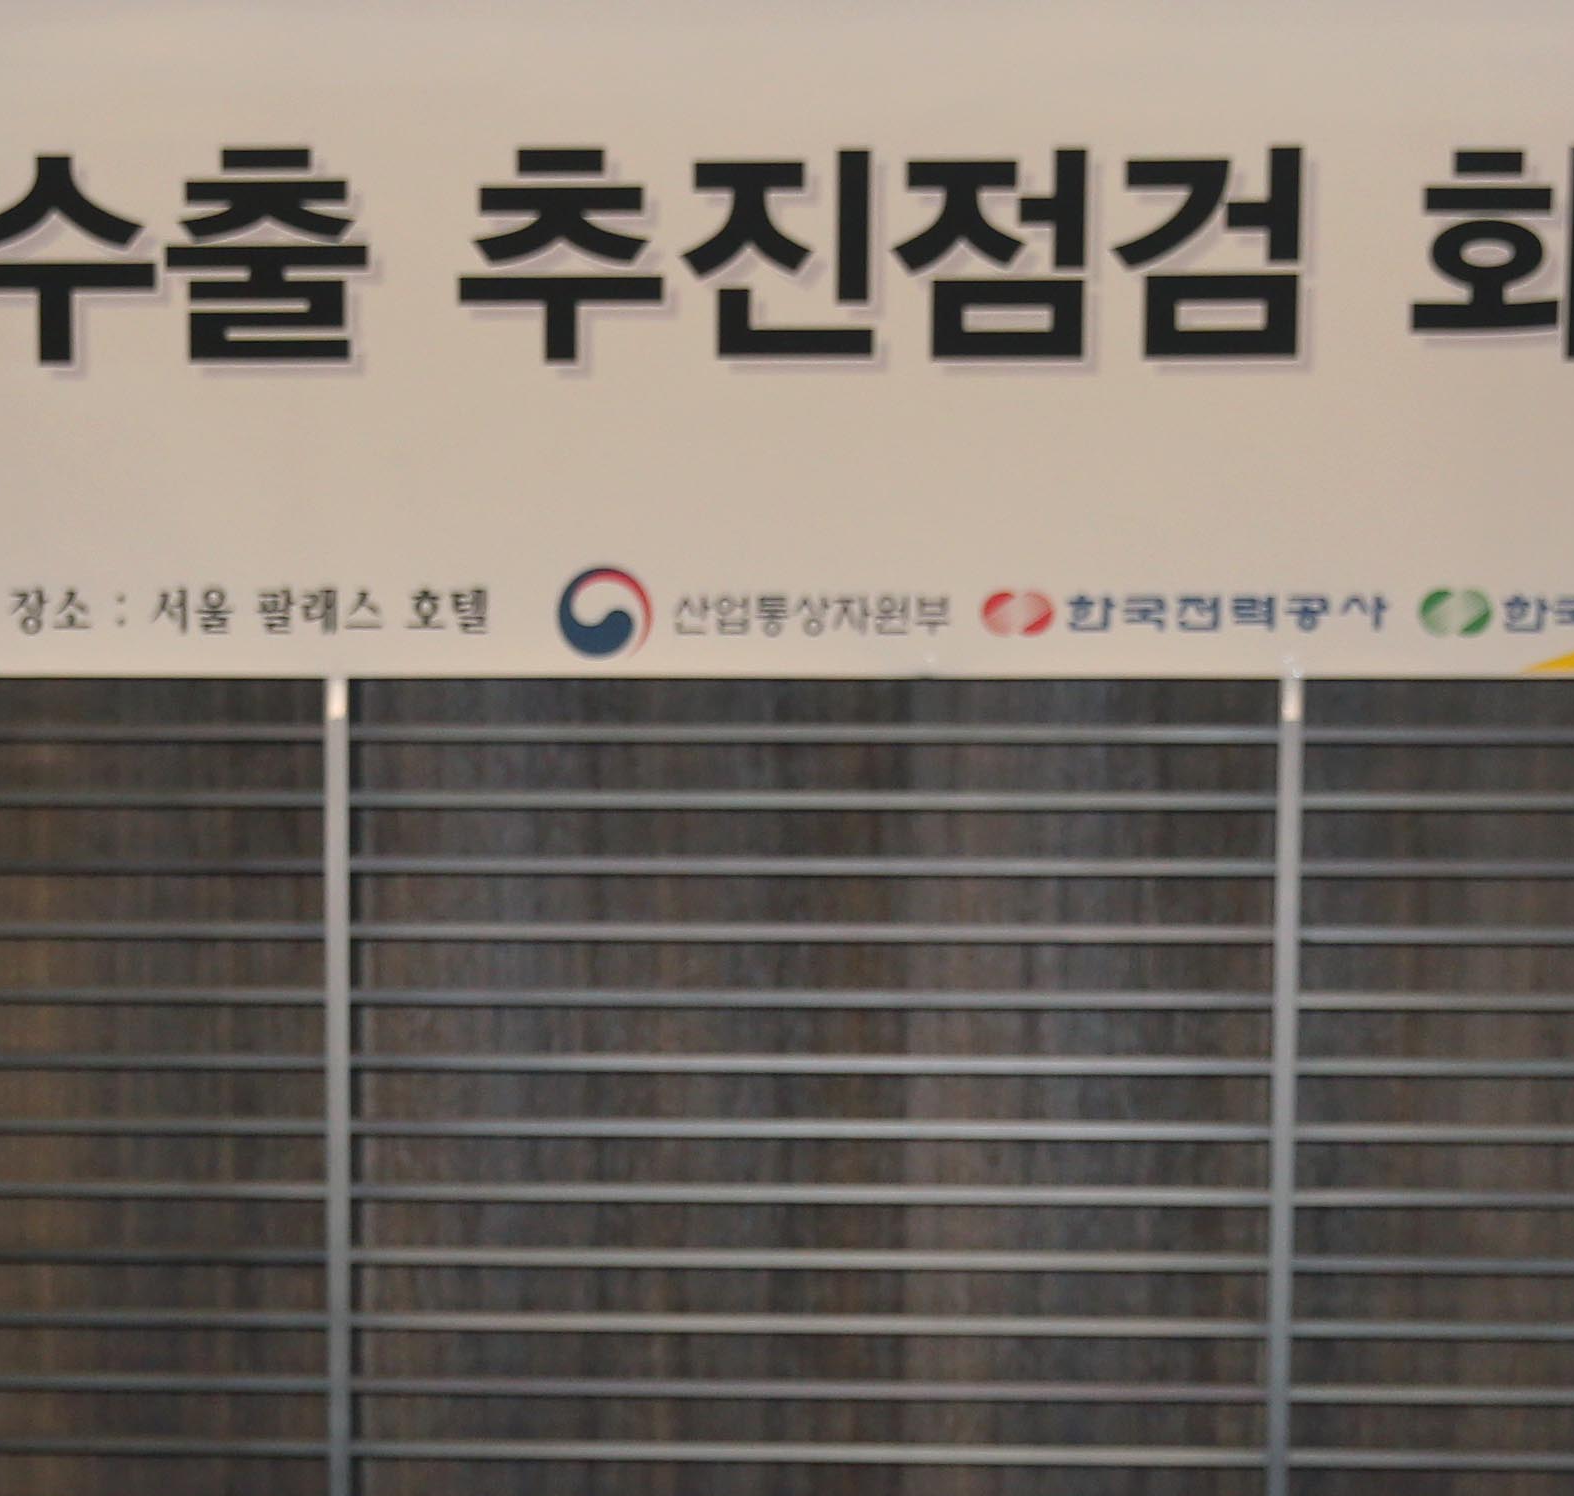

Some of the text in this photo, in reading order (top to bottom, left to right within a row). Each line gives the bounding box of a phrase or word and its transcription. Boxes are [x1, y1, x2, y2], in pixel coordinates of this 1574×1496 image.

[457, 145, 1303, 363] 추진점검
[11, 587, 91, 635] 장소
[153, 586, 233, 634] 서울
[257, 586, 382, 634] 팔래스
[406, 586, 488, 634] 호텔
[675, 595, 950, 637] 산업통상자원부
[1067, 594, 1389, 633] 한국전력공사
